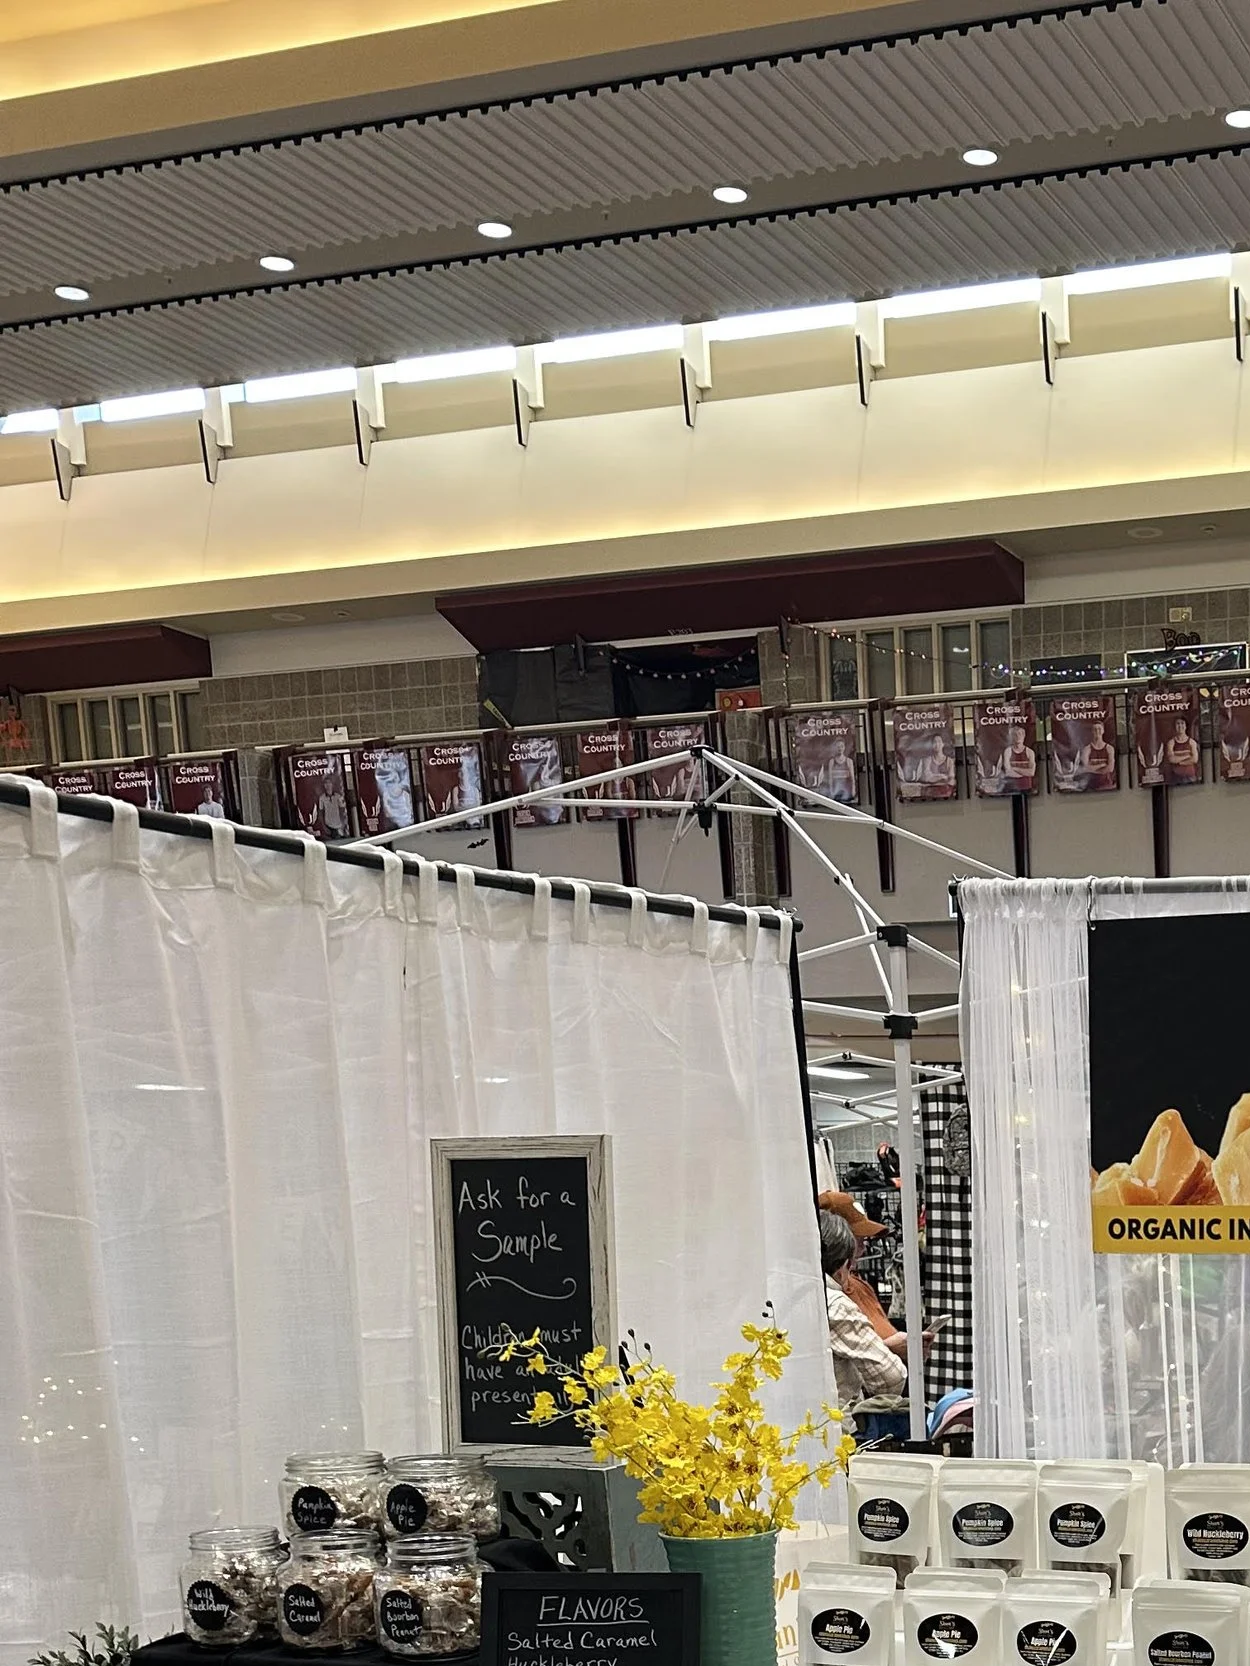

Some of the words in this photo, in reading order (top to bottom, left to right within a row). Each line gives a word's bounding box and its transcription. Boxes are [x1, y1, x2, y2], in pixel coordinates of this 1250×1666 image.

[1145, 692, 1183, 703] CROSS
[986, 706, 1021, 715] CROSS
[1062, 700, 1099, 710] CROSS
[1139, 702, 1191, 715] COUNTRY
[905, 711, 940, 721] CROSS
[980, 715, 1028, 726] COUNTRY
[1056, 710, 1107, 722] COUNTRY
[807, 718, 842, 728] CROSS
[899, 720, 947, 732] COUNTRY
[801, 727, 849, 738] COUNTRY
[297, 758, 329, 769] CROSS
[118, 771, 146, 780] CROSS
[179, 766, 209, 775] CROSS
[294, 766, 335, 779] COUNTRY
[114, 780, 153, 789] COUNTRY
[175, 774, 217, 784] COUNTRY
[457, 1180, 502, 1214] Ask
[516, 1176, 551, 1209] for
[560, 1191, 576, 1206] a
[1107, 1217, 1222, 1241] ORGANIC
[471, 1220, 563, 1264] Sample
[464, 1356, 503, 1380] have
[471, 1388, 538, 1412] present
[391, 1501, 416, 1515] Apple
[298, 1511, 328, 1526] Spice
[399, 1514, 416, 1527] Pie
[194, 1588, 213, 1600] Wild
[288, 1596, 316, 1608] Salted
[386, 1598, 413, 1610] Salted
[539, 1596, 644, 1621] FLAVORS
[507, 1632, 573, 1651] Salted
[580, 1629, 658, 1649] Caramel
